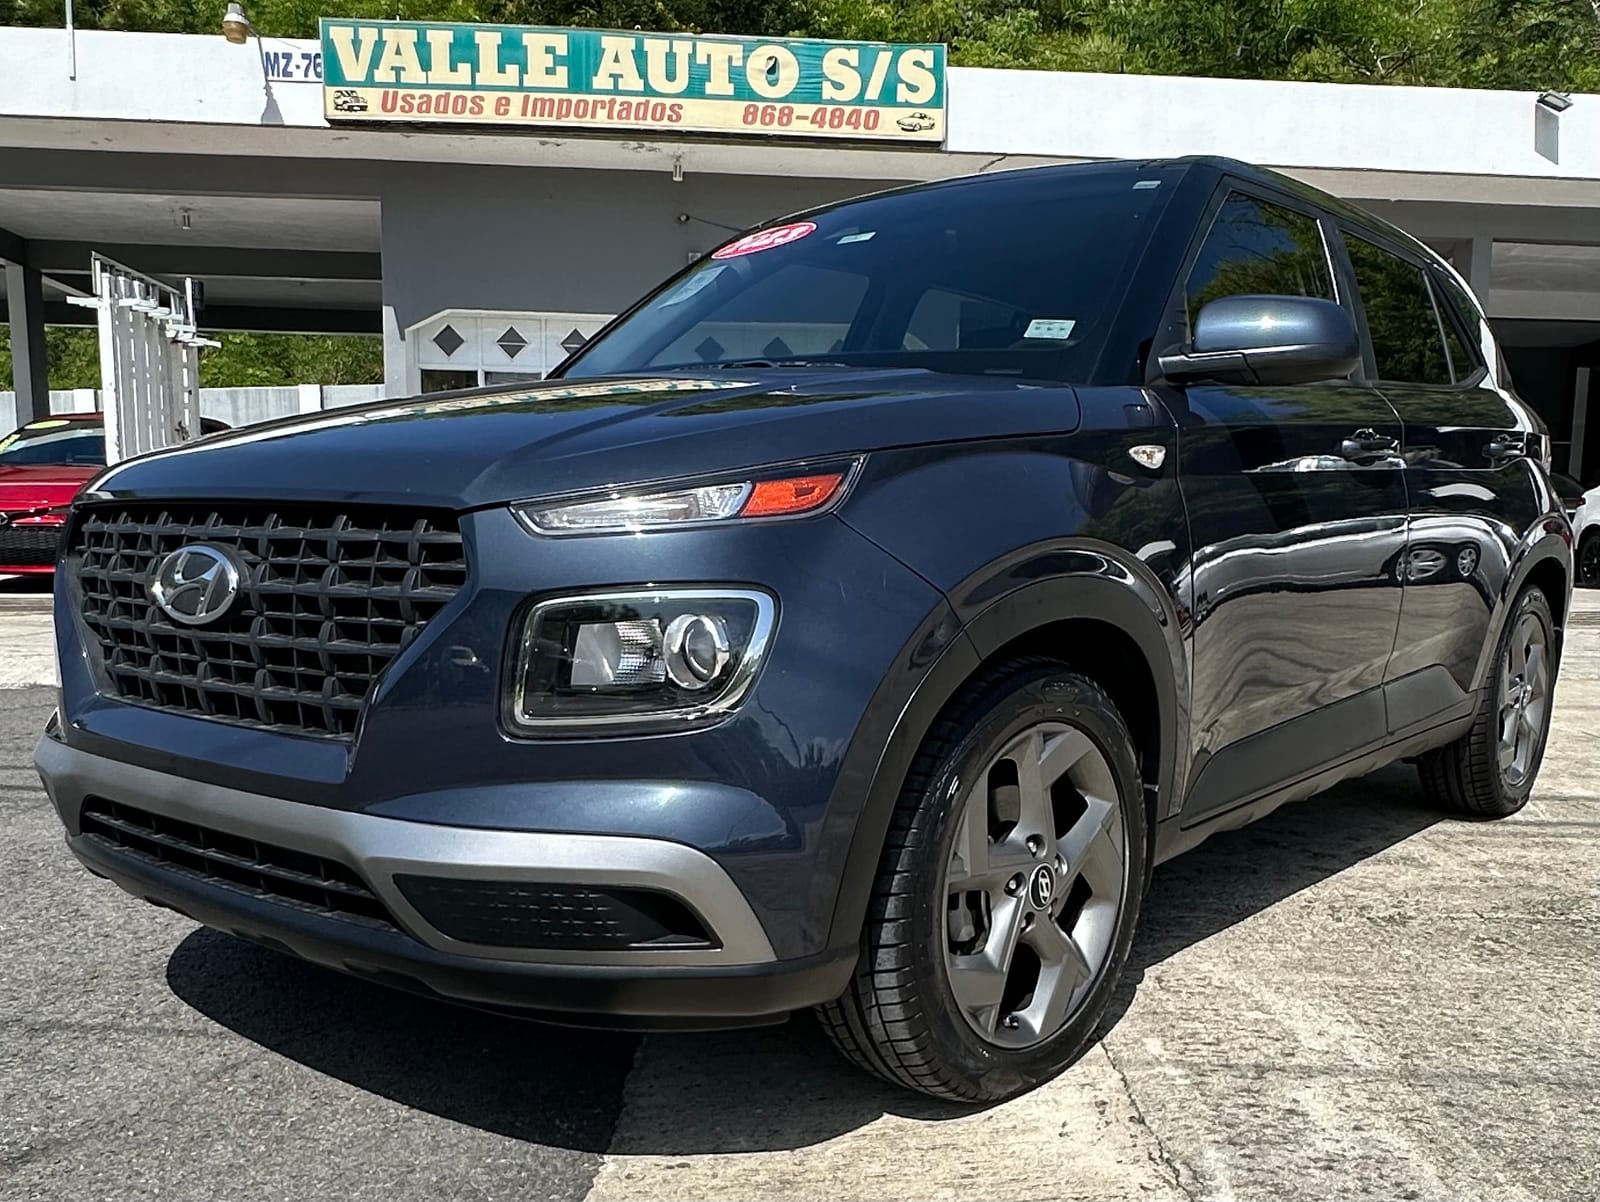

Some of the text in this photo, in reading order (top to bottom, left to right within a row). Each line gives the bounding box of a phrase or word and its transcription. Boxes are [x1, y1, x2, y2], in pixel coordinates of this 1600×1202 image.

[329, 26, 936, 104] VALLE AUTO S/S
[381, 90, 881, 131] Usados e Importados 868-4840
